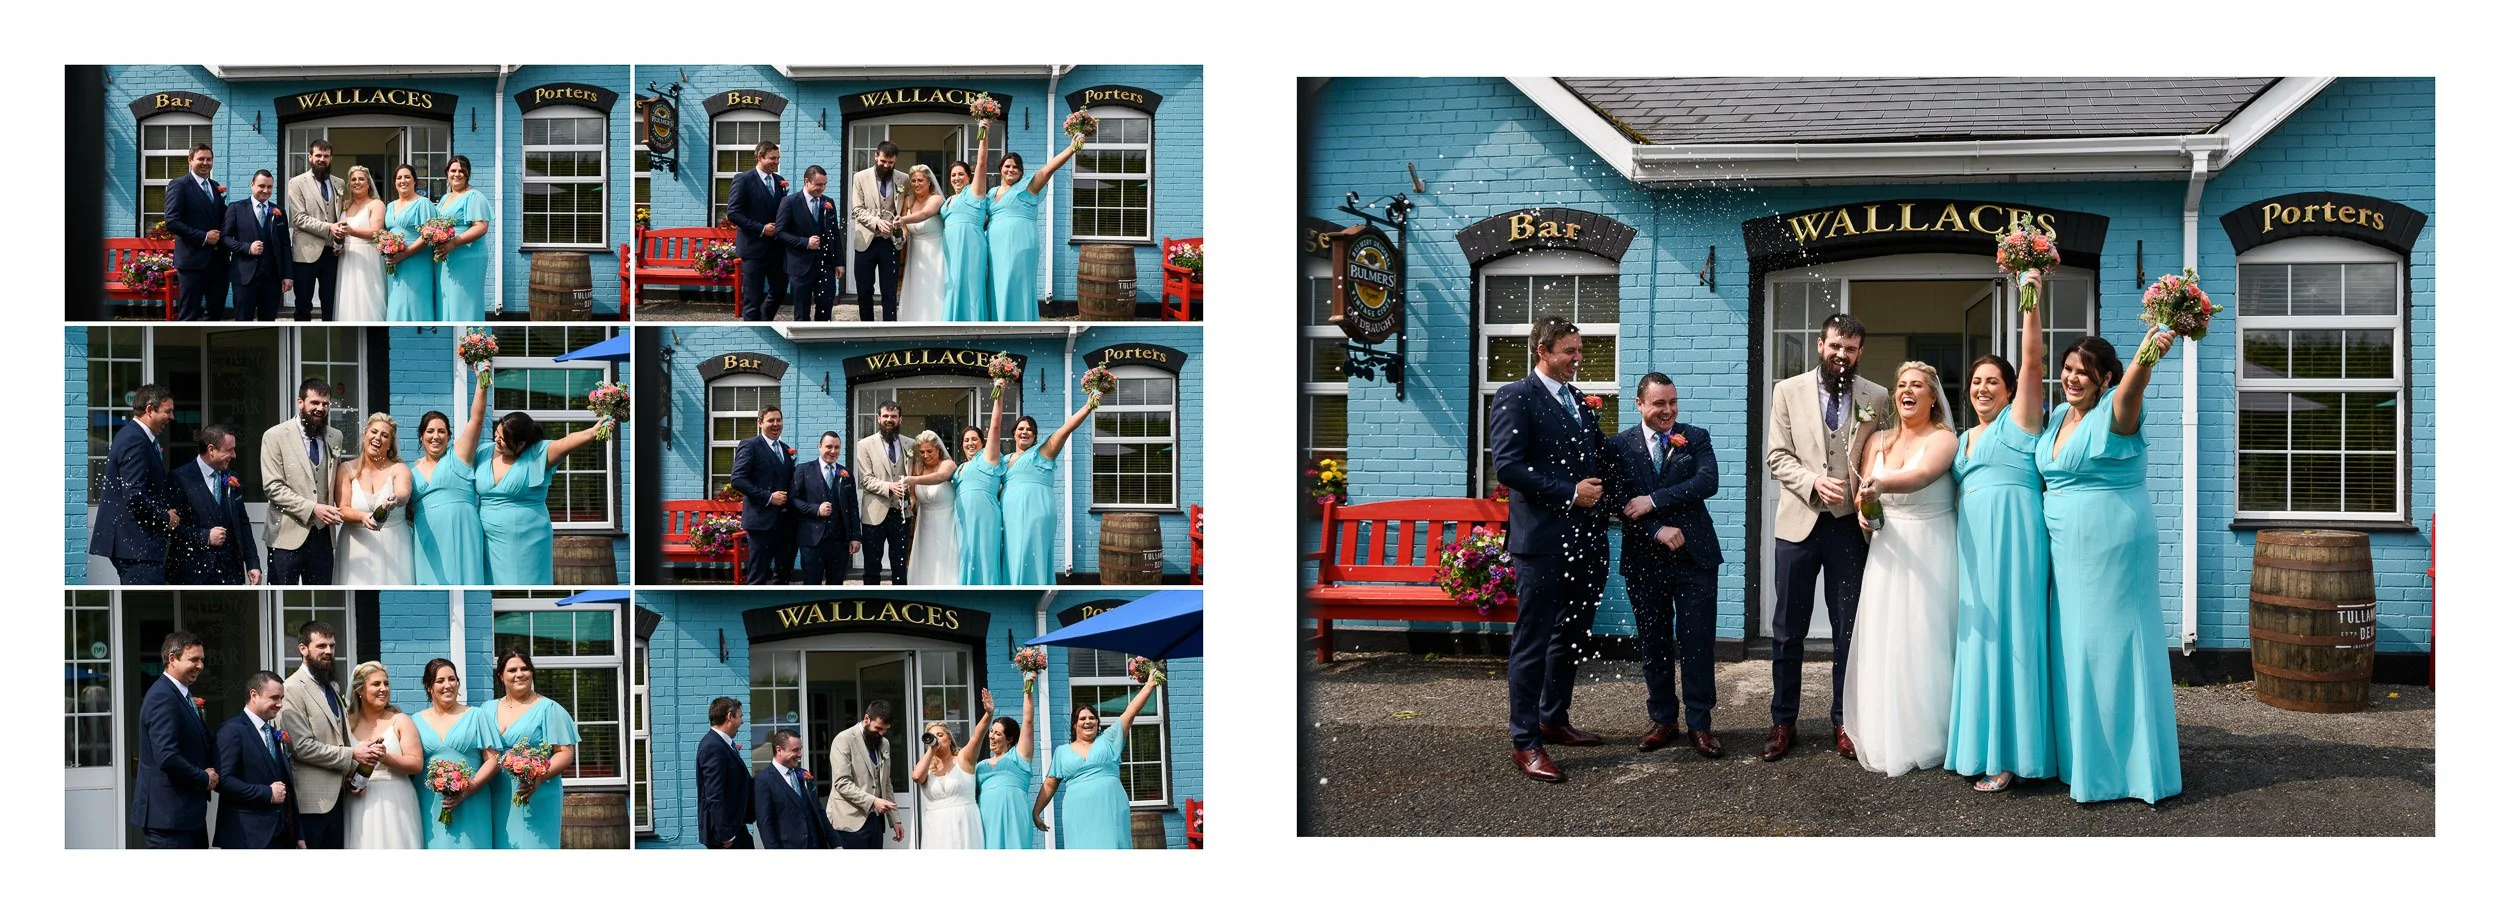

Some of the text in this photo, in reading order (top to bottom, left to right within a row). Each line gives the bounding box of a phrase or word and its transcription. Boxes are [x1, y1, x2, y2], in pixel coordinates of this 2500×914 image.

[156, 93, 193, 109] Bar
[297, 88, 432, 110] WALLACES
[536, 87, 598, 102] Porters
[727, 91, 762, 106] Bar
[860, 88, 976, 109] WALLACE
[1085, 88, 1143, 104] Porters
[1787, 203, 2057, 246] WALLACES
[2262, 201, 2386, 233] Porters
[1508, 213, 1583, 243] Bar
[1350, 264, 1395, 288] BULMERS
[1359, 313, 1395, 333] DRAUGHT
[723, 354, 761, 369] Bar
[866, 349, 999, 371] WALLACE
[1104, 347, 1167, 364] Porters
[776, 601, 959, 630] WALLACES
